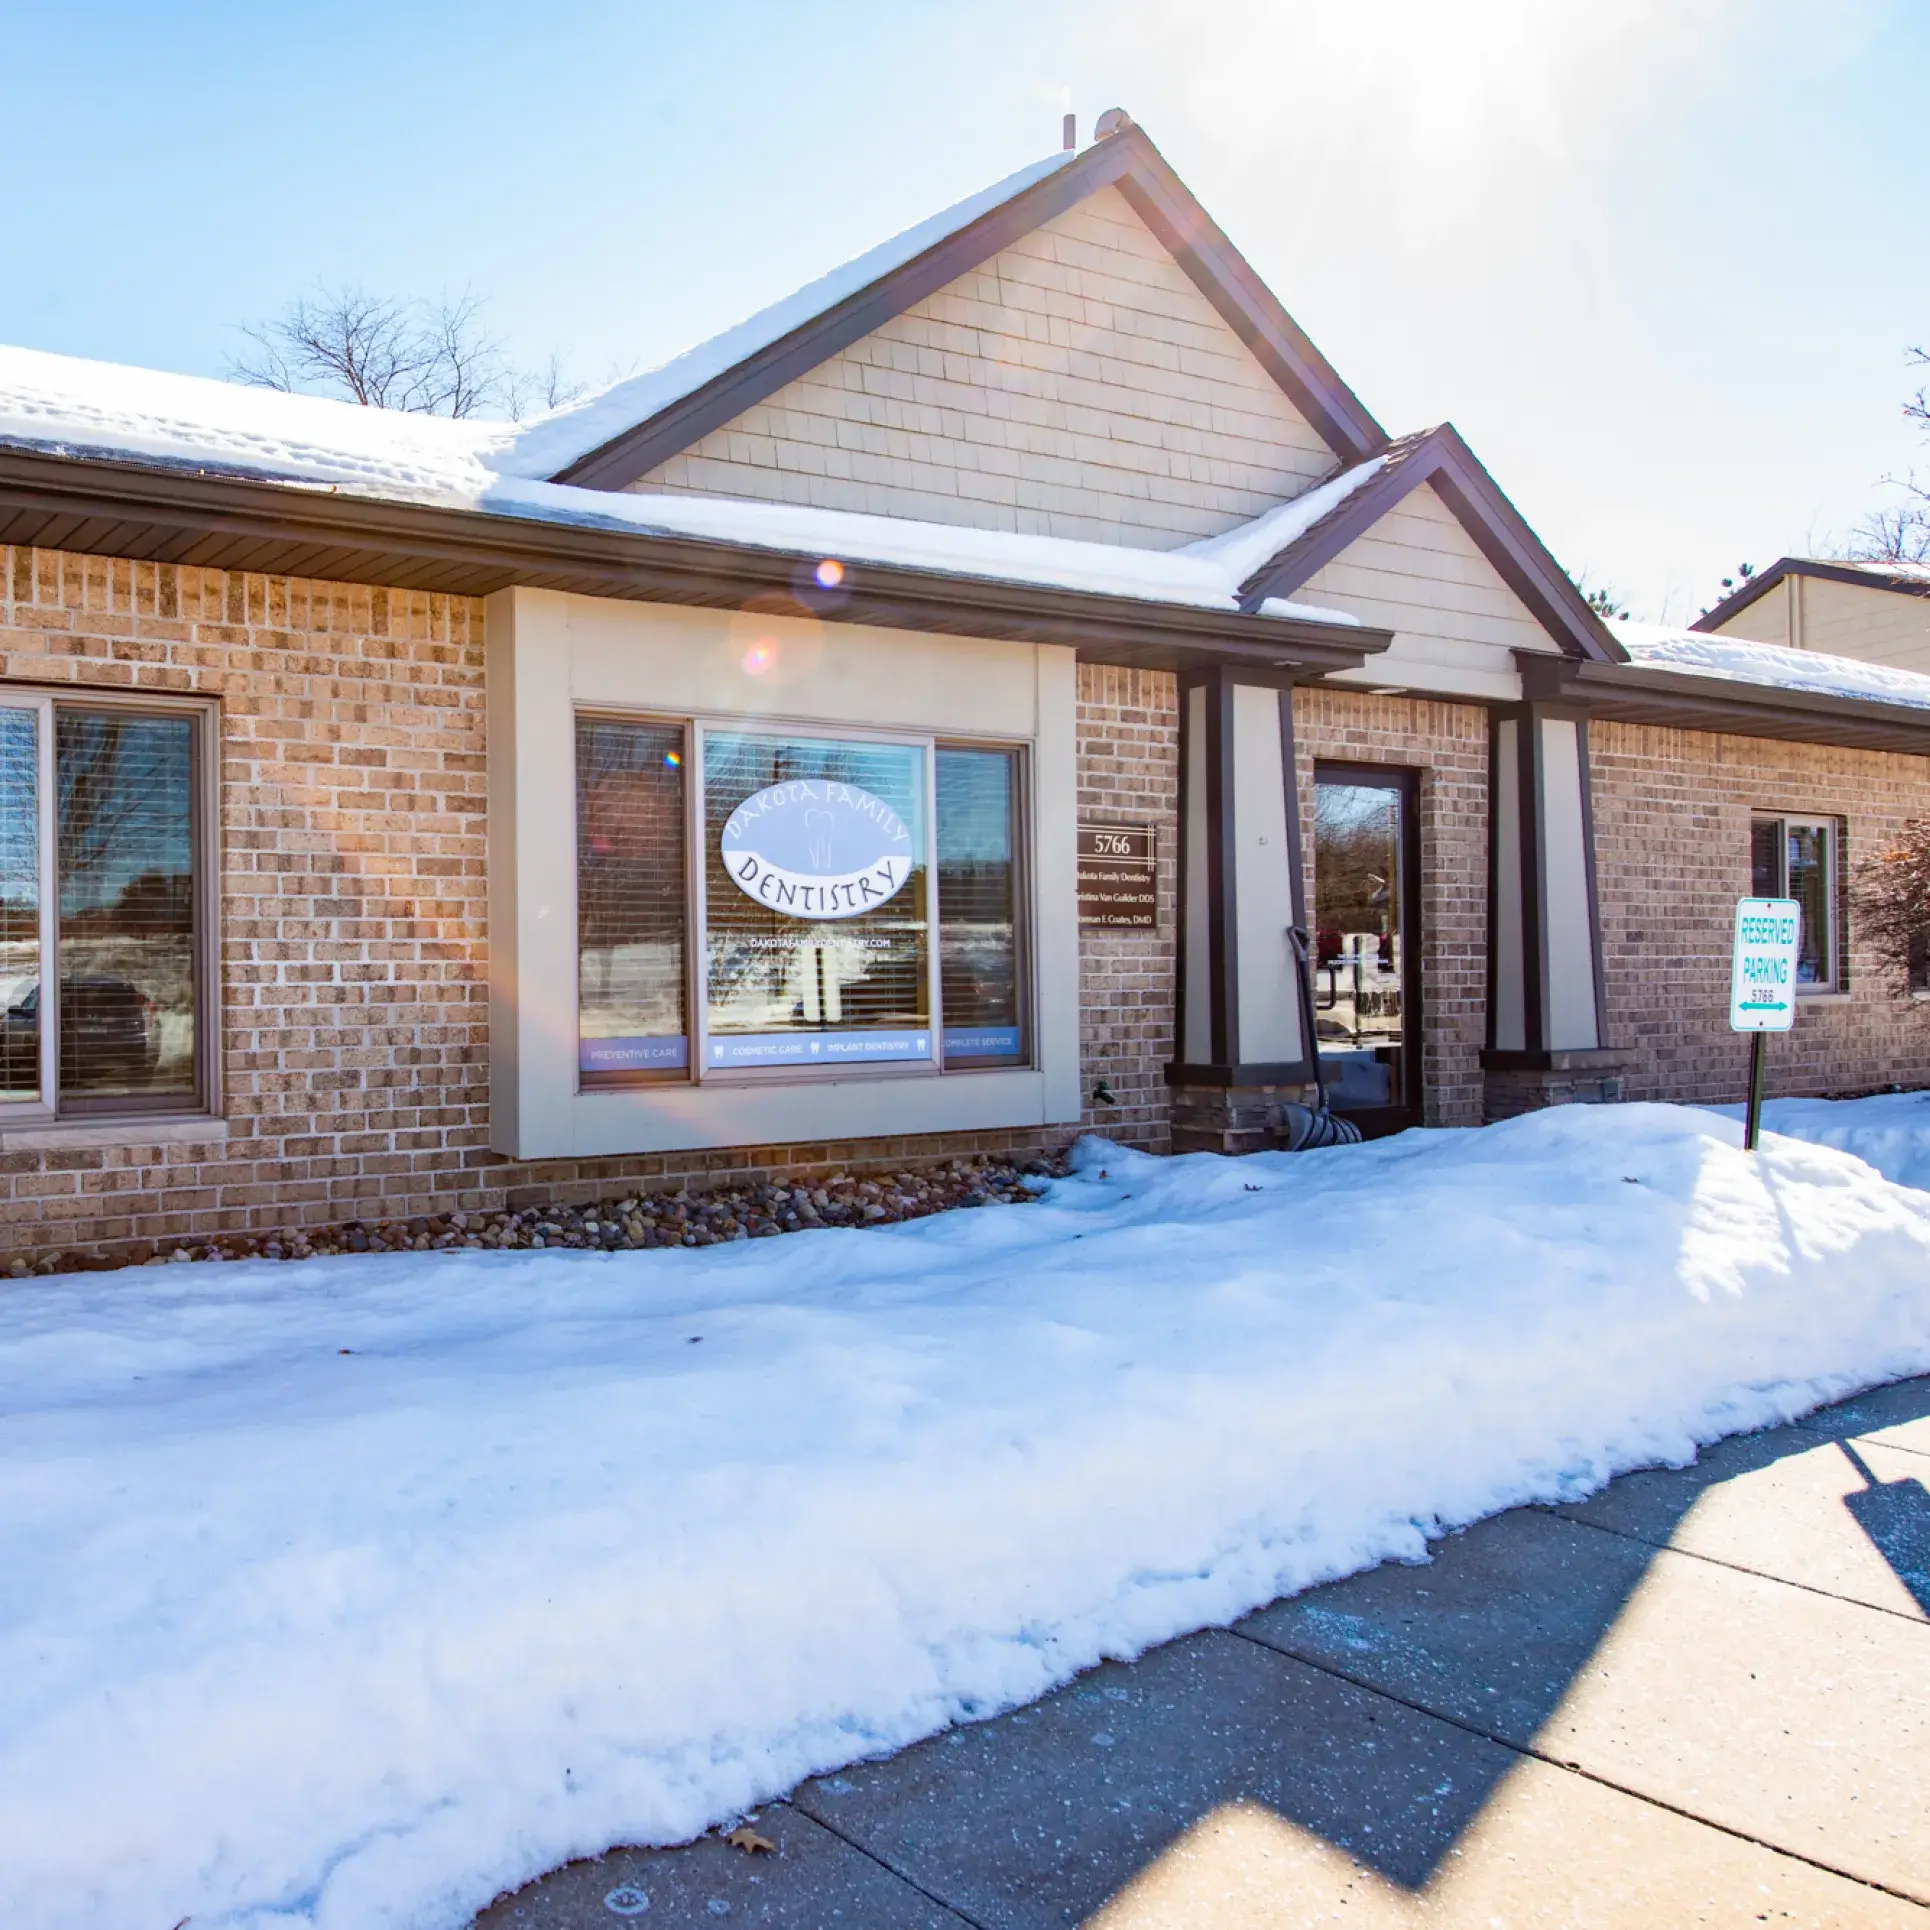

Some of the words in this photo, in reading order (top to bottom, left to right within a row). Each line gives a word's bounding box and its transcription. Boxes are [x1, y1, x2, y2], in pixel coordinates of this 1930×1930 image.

[726, 781, 818, 840] DAKOTA
[826, 784, 909, 842] FAMILY
[1094, 834, 1131, 854] 5766
[738, 856, 896, 911] DENTISTRY
[1099, 872, 1119, 884] Family
[1121, 873, 1151, 884] Dentistry
[1100, 893, 1112, 902] Van
[1139, 893, 1154, 903] DDS
[1077, 915, 1100, 923] orman
[1133, 915, 1152, 924] DMD
[1741, 917, 1794, 944] RESERVED
[1743, 957, 1787, 984] PARKING
[1751, 989, 1774, 1002] 5766
[732, 1045, 777, 1056] COSMETIC
[779, 1044, 804, 1054] CARE
[827, 1042, 863, 1052] IMPLANT
[866, 1041, 909, 1051] DENTISTRY
[591, 1049, 650, 1060] PREVENTIVE
[651, 1047, 678, 1057] CARE
